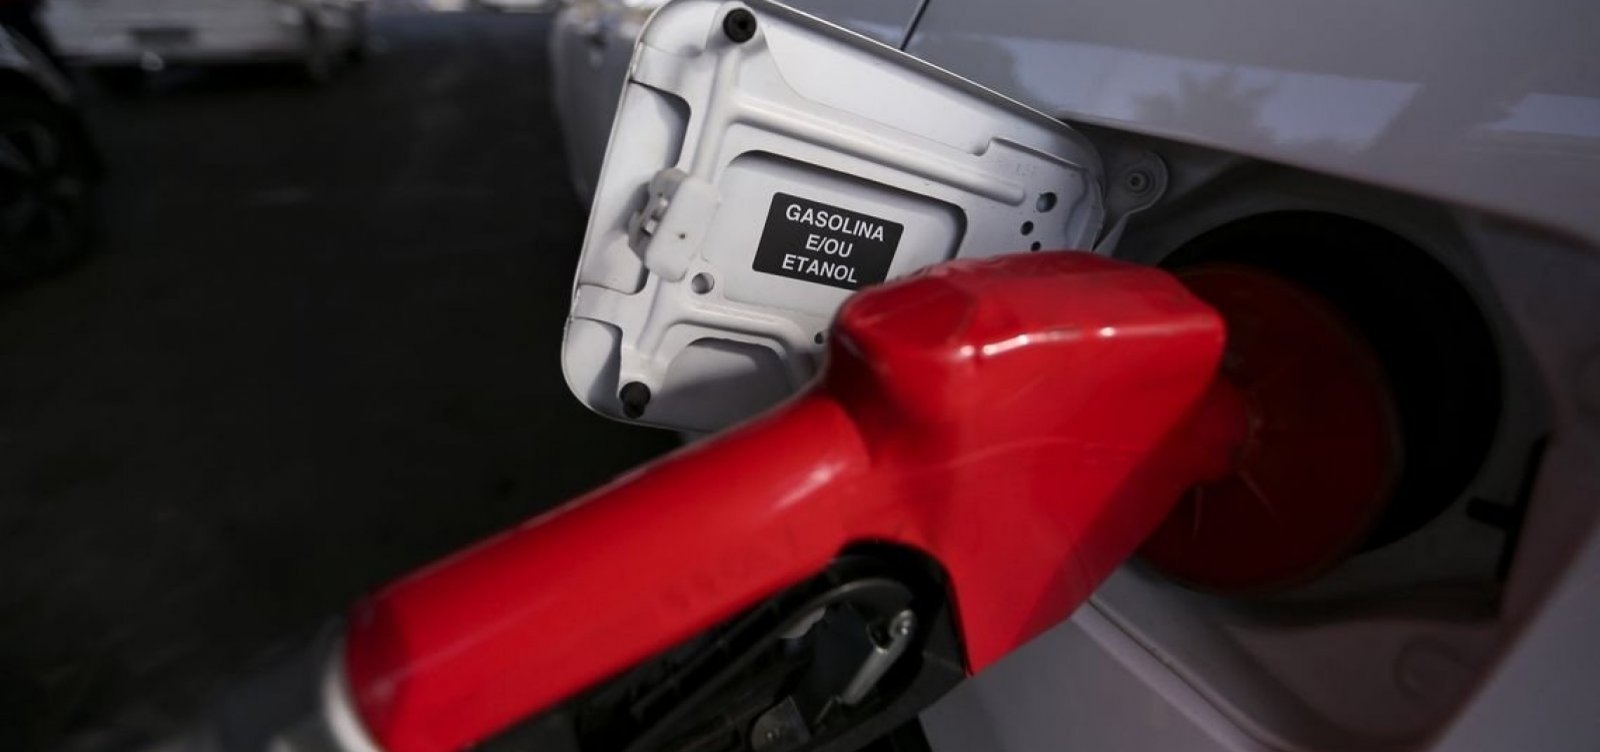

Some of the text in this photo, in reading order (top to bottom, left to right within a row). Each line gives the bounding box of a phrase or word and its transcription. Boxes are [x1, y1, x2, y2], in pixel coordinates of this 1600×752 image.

[785, 204, 884, 242] GASOLINA
[805, 233, 853, 258] E/OU
[782, 253, 858, 283] ETANOL
